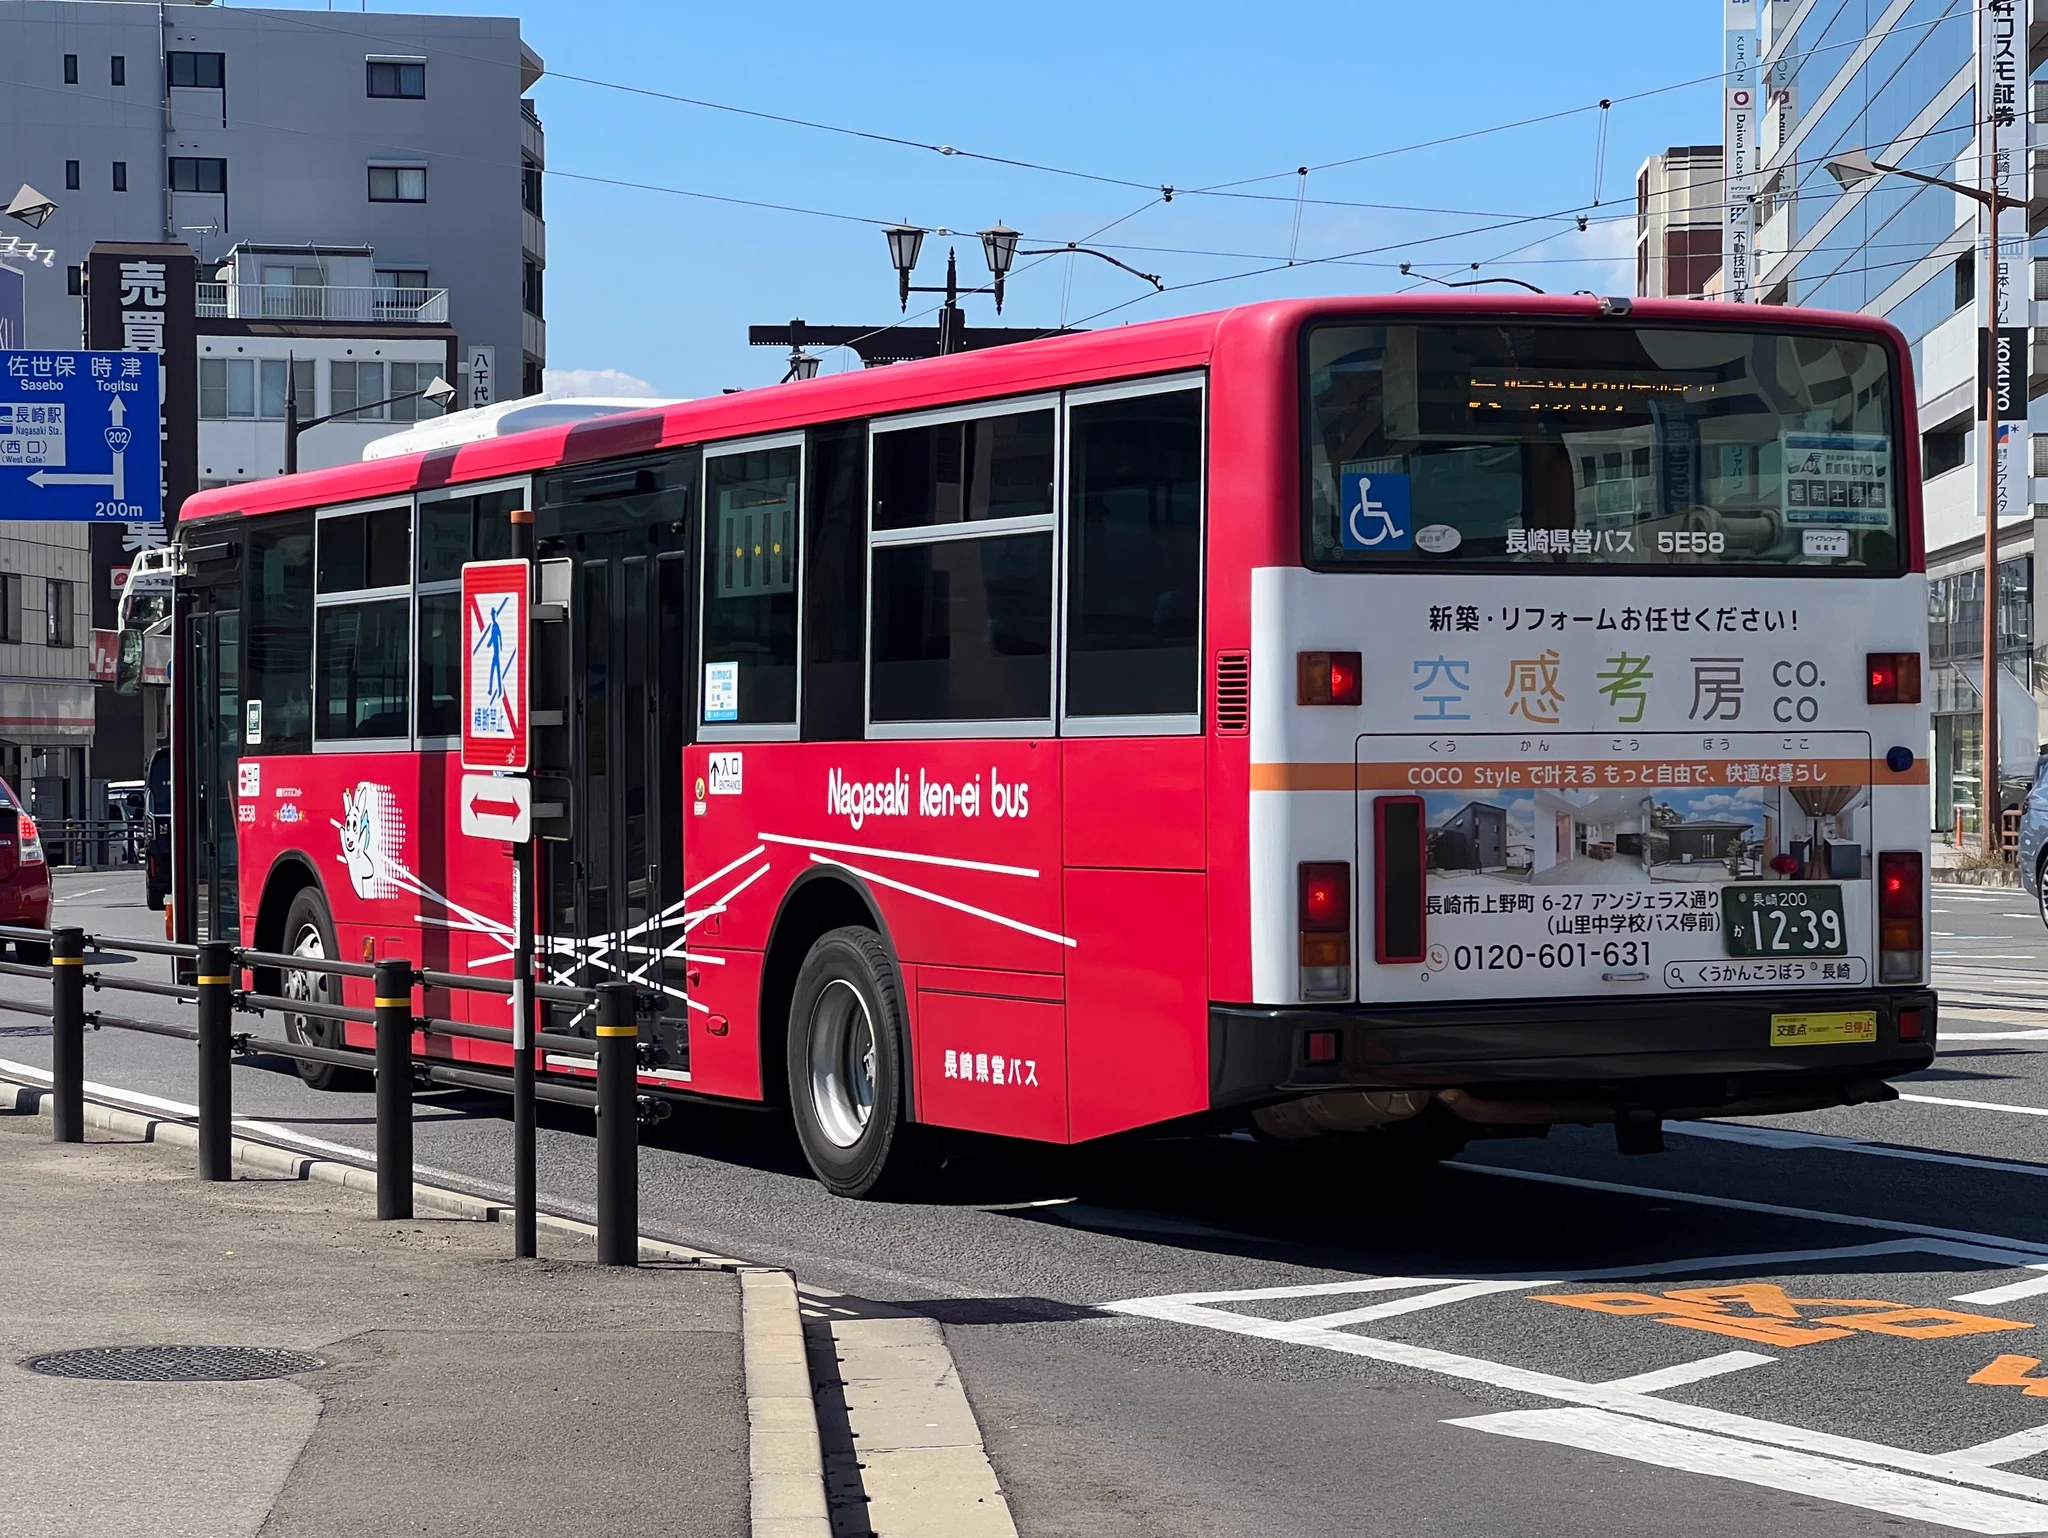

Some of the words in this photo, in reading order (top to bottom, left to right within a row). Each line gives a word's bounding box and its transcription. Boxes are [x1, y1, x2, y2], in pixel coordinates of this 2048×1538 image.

[1736, 36, 1746, 82] KUMON
[1736, 114, 1746, 149] Daiwa
[1736, 150, 1746, 182] Lease
[1733, 231, 1746, 304] 不動技研工業
[1998, 262, 2010, 324] 日本トリム
[7, 356, 76, 377] 佐世保
[91, 356, 142, 378] 時津
[1998, 337, 2010, 411] KOKUYO
[20, 378, 64, 390] Sasebo
[96, 380, 138, 393] Togitsu
[474, 354, 489, 408] 八千代
[16, 406, 62, 424] 長崎駅
[16, 426, 46, 436] Nagasaki
[48, 426, 62, 436] Sta.
[108, 431, 127, 444] 202
[1791, 484, 1883, 503] 運転士募集
[95, 502, 143, 517] 200m
[1505, 528, 1635, 554] 長崎県営バス
[1657, 530, 1724, 554] 5E58
[1429, 605, 1799, 632] 新築・リフォームお任せください!
[1413, 648, 1745, 724] 空感考房
[1772, 660, 1826, 688] CO.
[1772, 695, 1819, 723] CO
[721, 758, 739, 776] 入口
[1408, 766, 1463, 784] COCO
[1474, 767, 1521, 788] Style
[1526, 766, 1596, 784] で叶える
[828, 766, 910, 830] Nagasaki
[920, 766, 980, 817] ken-ei
[991, 766, 1029, 818] bus
[1426, 894, 1535, 915] 長崎市上野町
[1542, 894, 1583, 912] 6-27
[1591, 890, 1719, 911] アンジェラス通り
[1753, 892, 1808, 907] 長崎200
[1548, 912, 1721, 936] (山里中学校バス停前)
[1733, 926, 1745, 938] か
[1752, 909, 1842, 950] 12-39
[1454, 941, 1650, 970] 0120-601-631
[1698, 964, 1806, 982] くうかんこうぼう
[1822, 963, 1850, 980] 長崎
[1776, 1024, 1807, 1037] 交差点
[1834, 1020, 1873, 1034] 一旦停止
[944, 1049, 1038, 1088] 長崎県営バス
